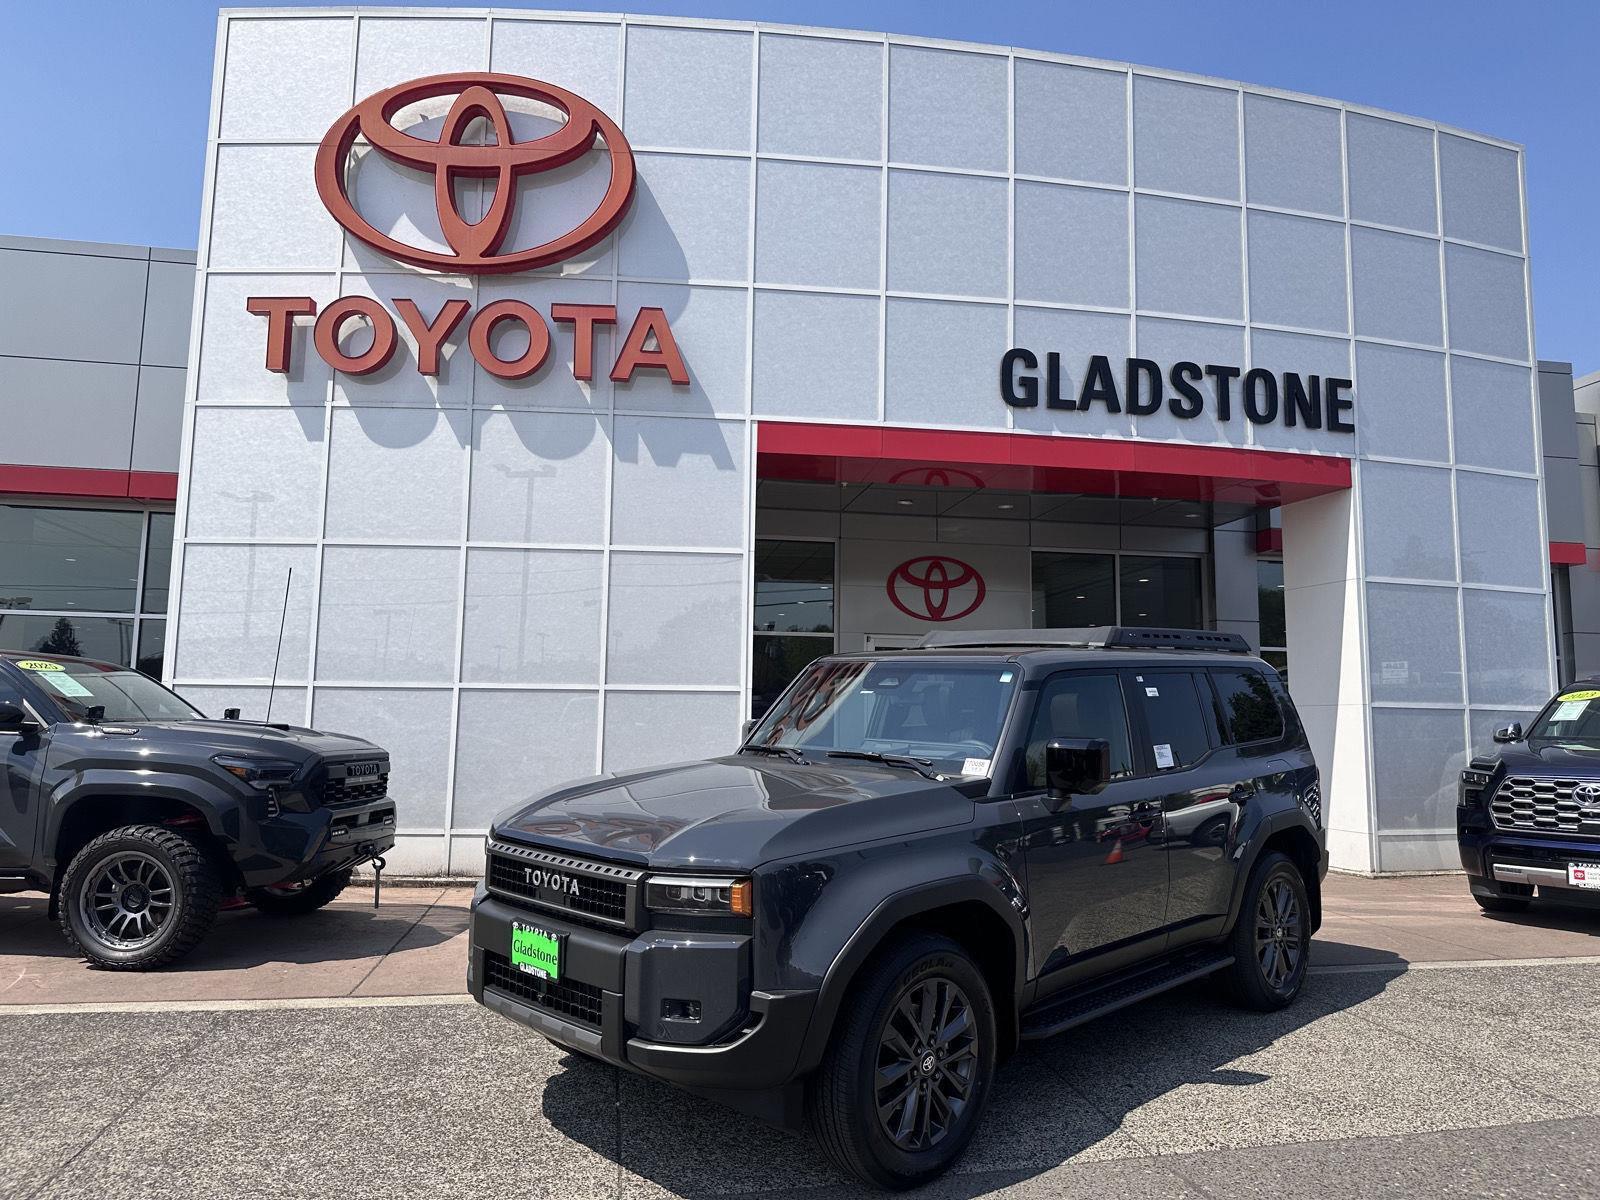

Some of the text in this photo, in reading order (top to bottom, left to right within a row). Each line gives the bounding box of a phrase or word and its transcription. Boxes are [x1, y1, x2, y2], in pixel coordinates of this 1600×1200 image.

[246, 295, 690, 385] TOYOTA
[1000, 348, 1355, 433] GLADSTONE
[351, 764, 378, 776] TOYOTA
[524, 868, 580, 895] TOYOTA
[522, 924, 548, 937] TOYOTA
[513, 939, 557, 965] Gladstone
